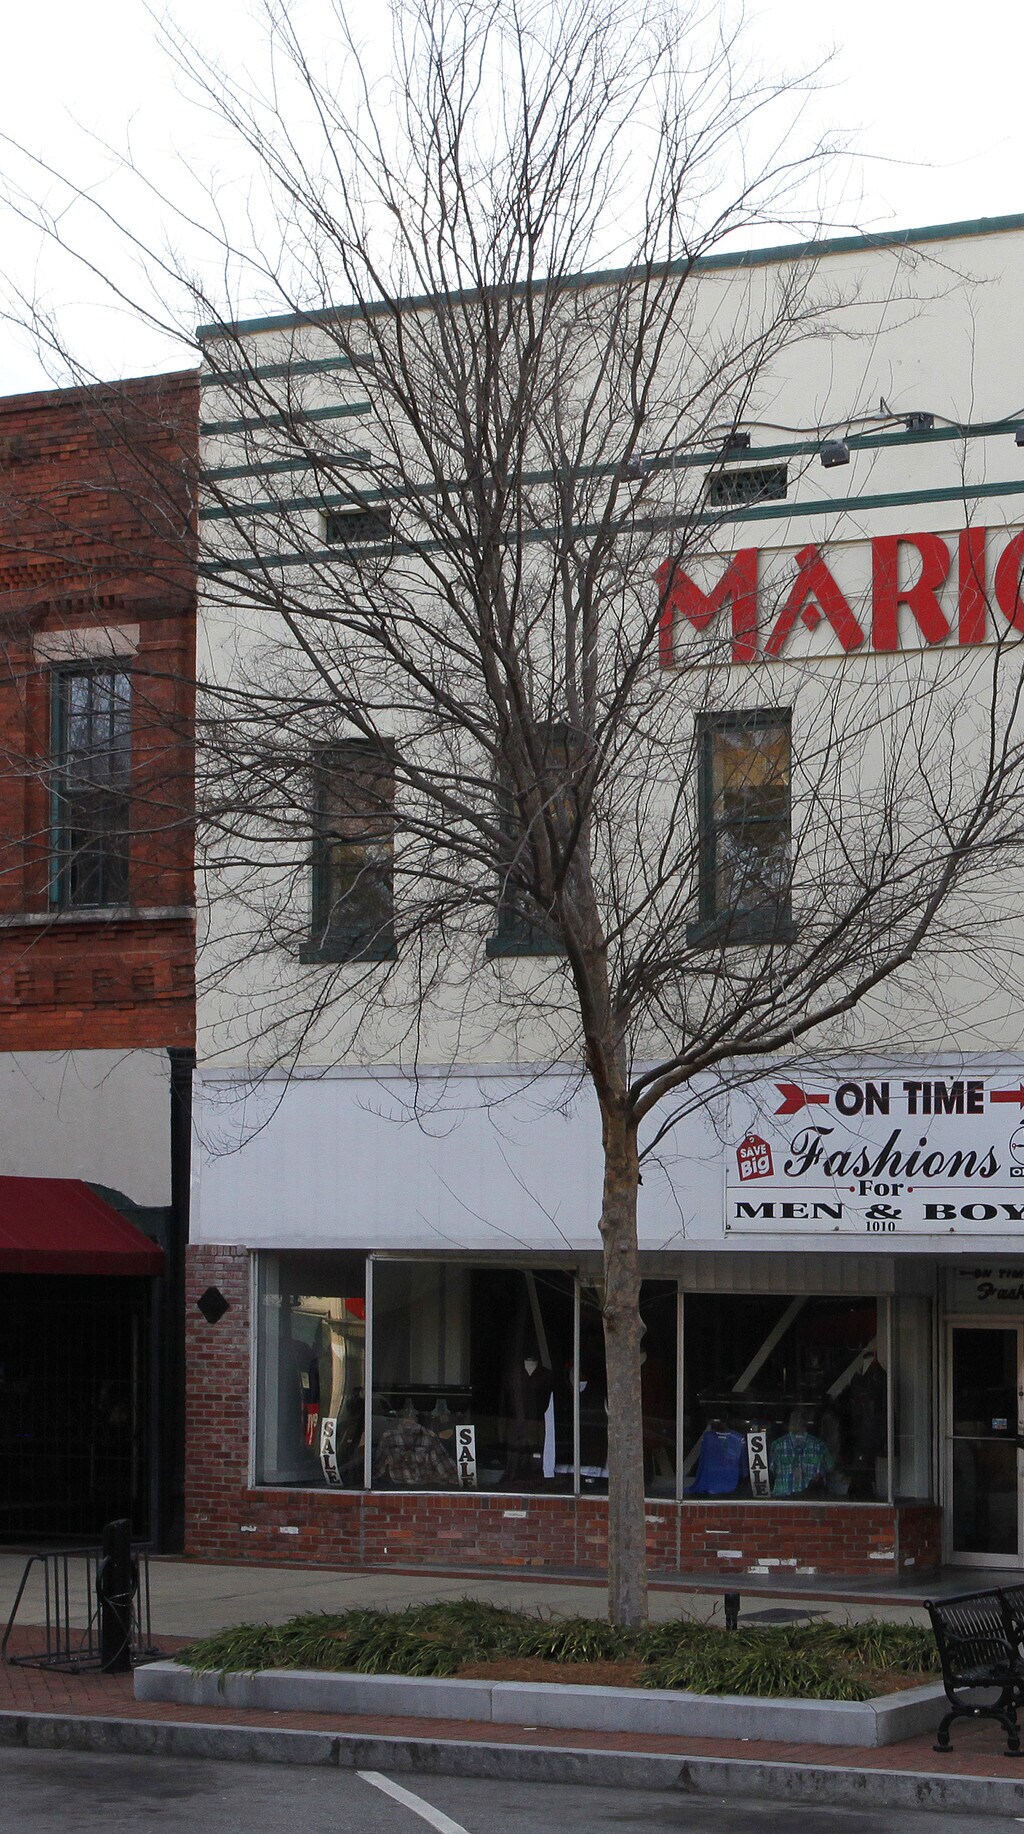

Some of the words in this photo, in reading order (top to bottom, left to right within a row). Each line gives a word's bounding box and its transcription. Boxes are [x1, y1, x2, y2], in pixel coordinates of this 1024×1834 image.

[834, 1081, 891, 1116] ON
[902, 1081, 985, 1115] TIME
[740, 1144, 767, 1159] SAVE
[783, 1125, 1002, 1179] Fashions
[858, 1179, 904, 1198] For
[734, 1202, 844, 1219] MEN
[864, 1203, 903, 1221] &
[865, 1221, 896, 1232] 1010
[322, 1421, 340, 1483] SALE
[750, 1436, 769, 1496] SALE
